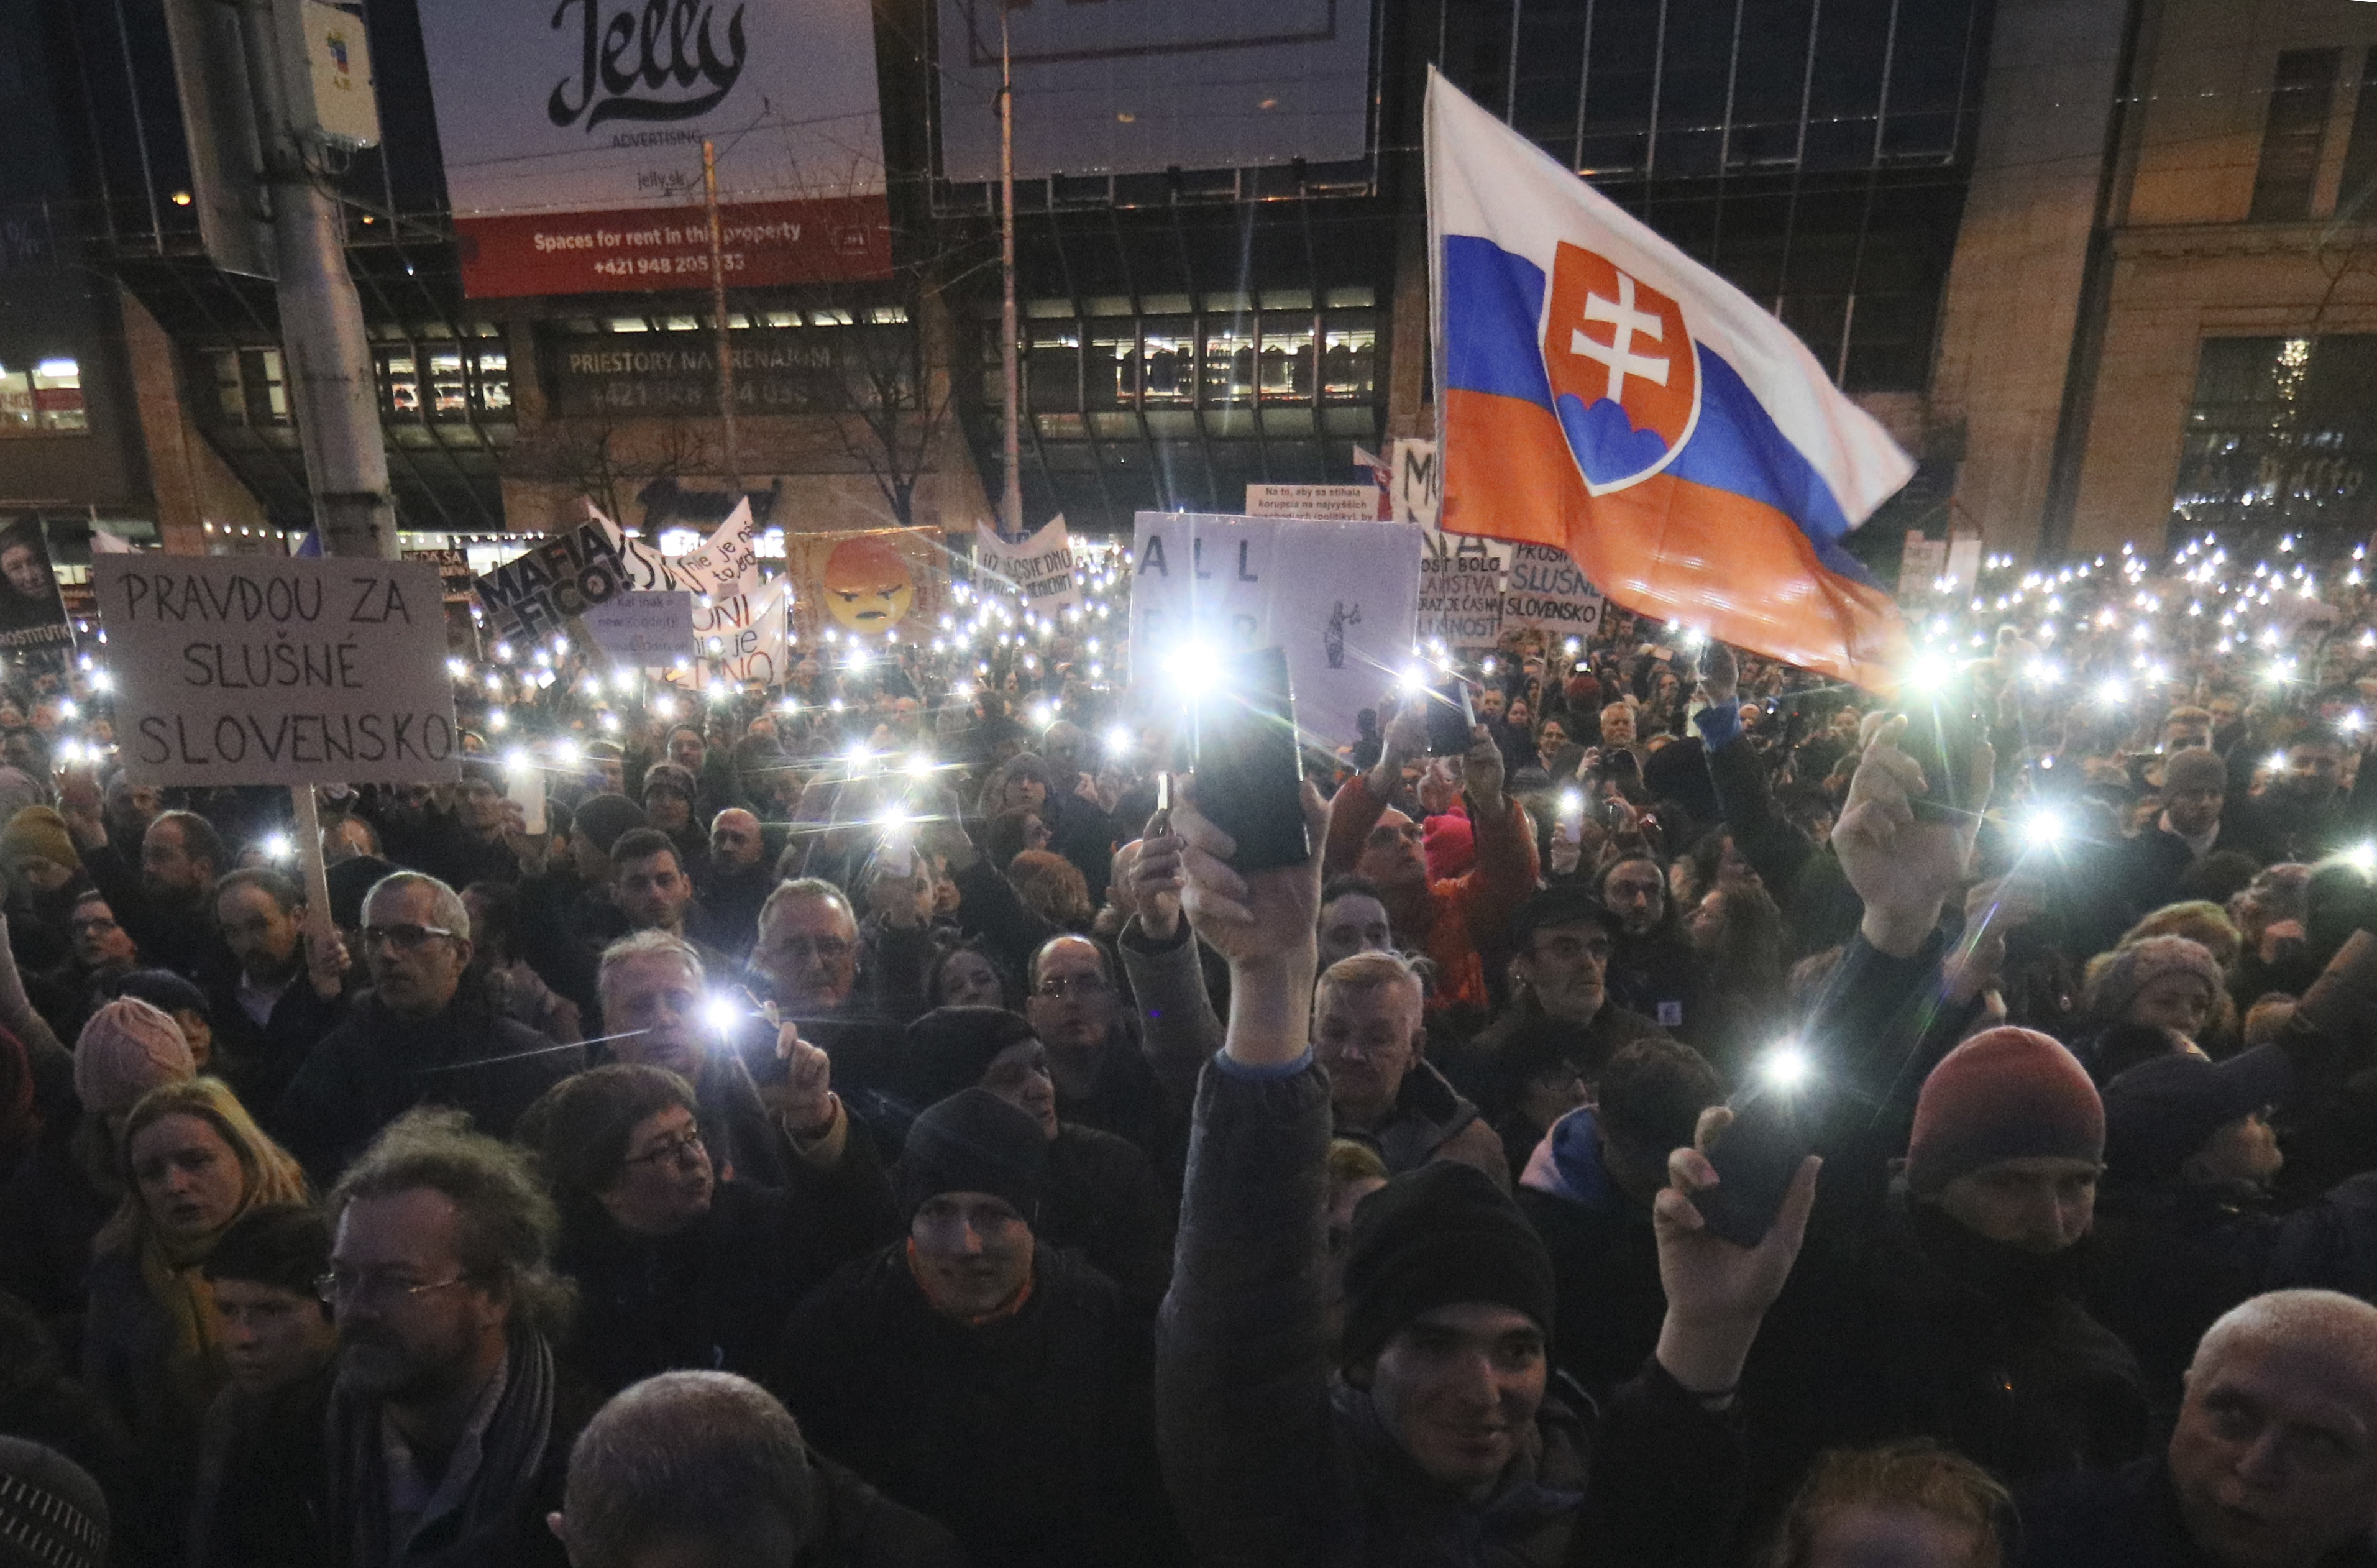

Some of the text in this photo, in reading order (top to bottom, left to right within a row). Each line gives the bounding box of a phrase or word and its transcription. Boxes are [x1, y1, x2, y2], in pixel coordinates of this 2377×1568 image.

[612, 131, 703, 149] ADVERTISING
[638, 170, 685, 191] jelly.sk
[534, 222, 801, 253] Spaces for rent in thi property
[594, 257, 634, 275] +421
[638, 257, 671, 273] 948
[569, 351, 675, 374] PRIESTORY
[680, 351, 712, 371] NA
[1258, 499, 1299, 510] korupcia
[1265, 488, 1278, 496] Na
[1296, 488, 1312, 498] aby
[473, 525, 616, 613] MAFIA
[1138, 535, 1258, 582] ALL
[1421, 557, 1500, 572] OST BOLO
[119, 572, 323, 623] PRAVDOU
[350, 577, 411, 624] ZA
[1506, 598, 1596, 623] SLOVENSKO
[733, 630, 758, 658] je
[183, 631, 364, 689] SLUŠNÉ
[139, 712, 454, 765] SLOVENSKO
